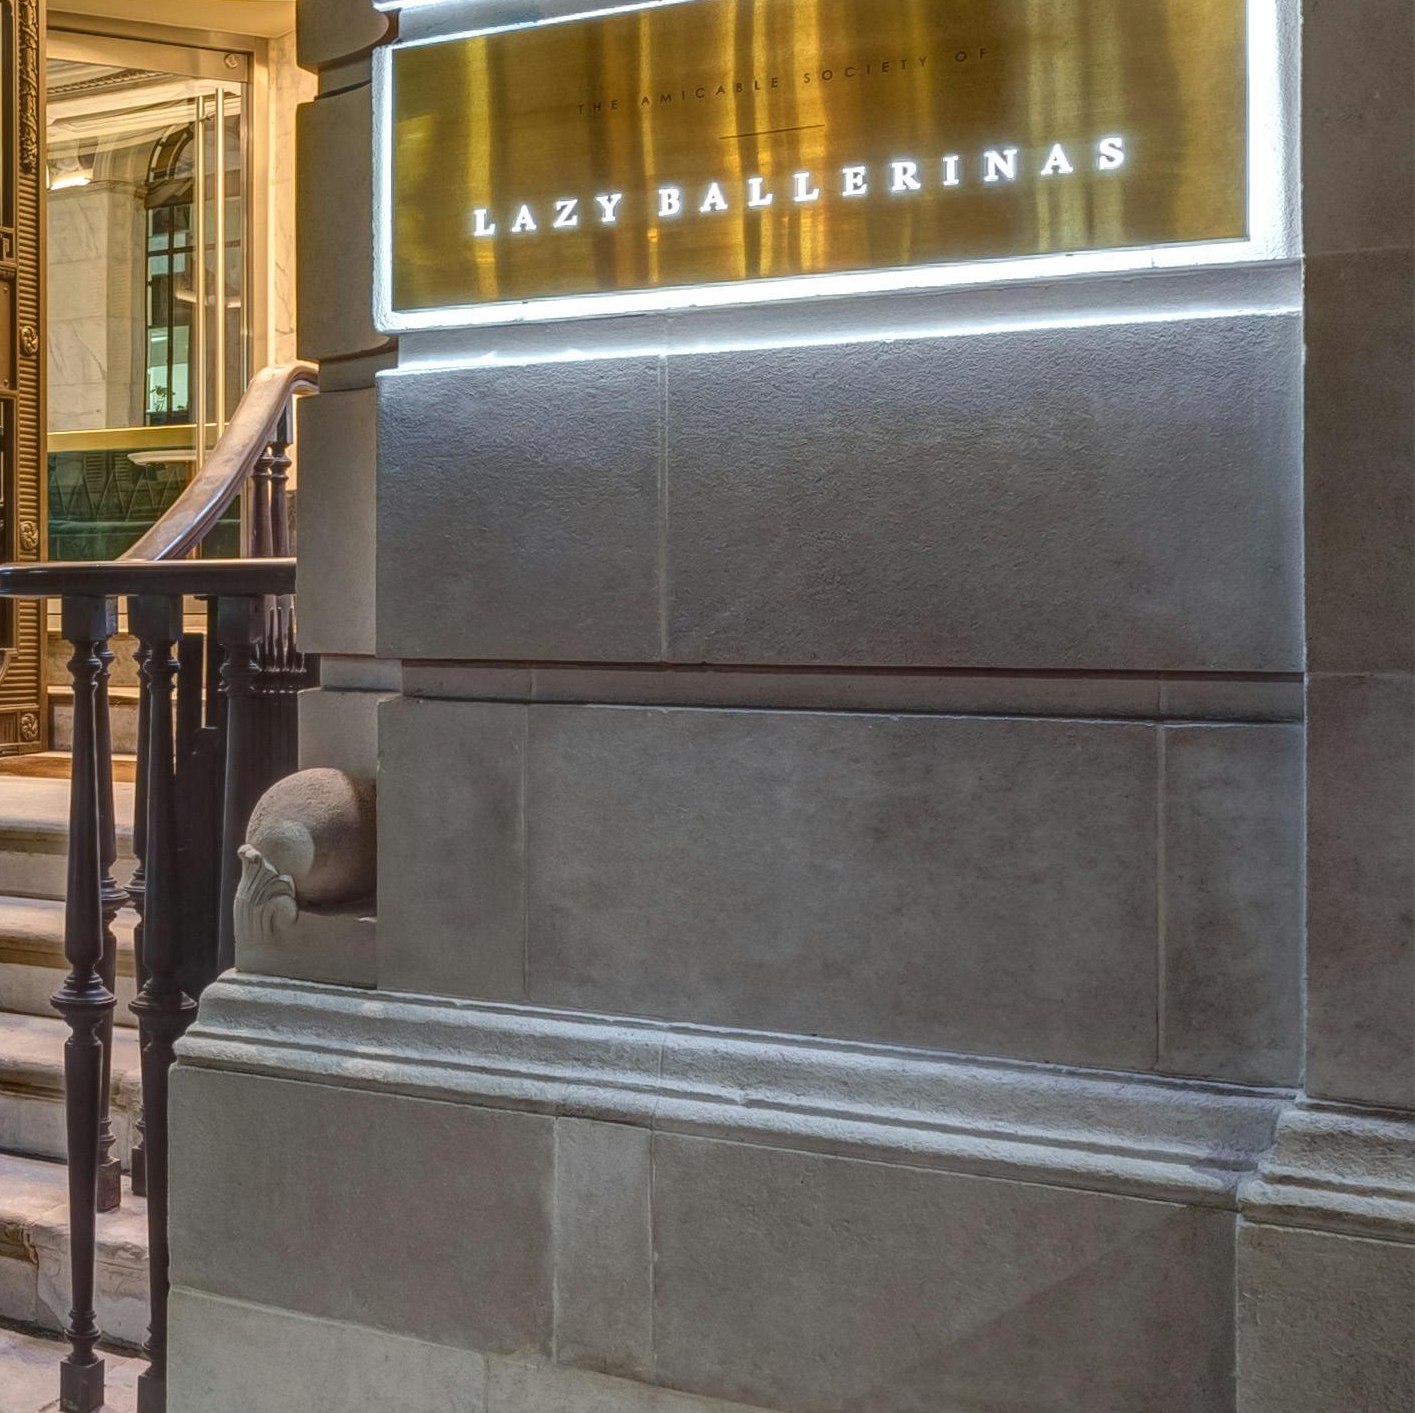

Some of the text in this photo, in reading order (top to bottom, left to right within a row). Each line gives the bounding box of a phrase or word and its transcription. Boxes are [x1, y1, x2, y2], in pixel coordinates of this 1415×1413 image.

[577, 47, 988, 115] THE AMICABLE SOCIETY OF
[473, 136, 1126, 238] LAZY BALLERINAS
